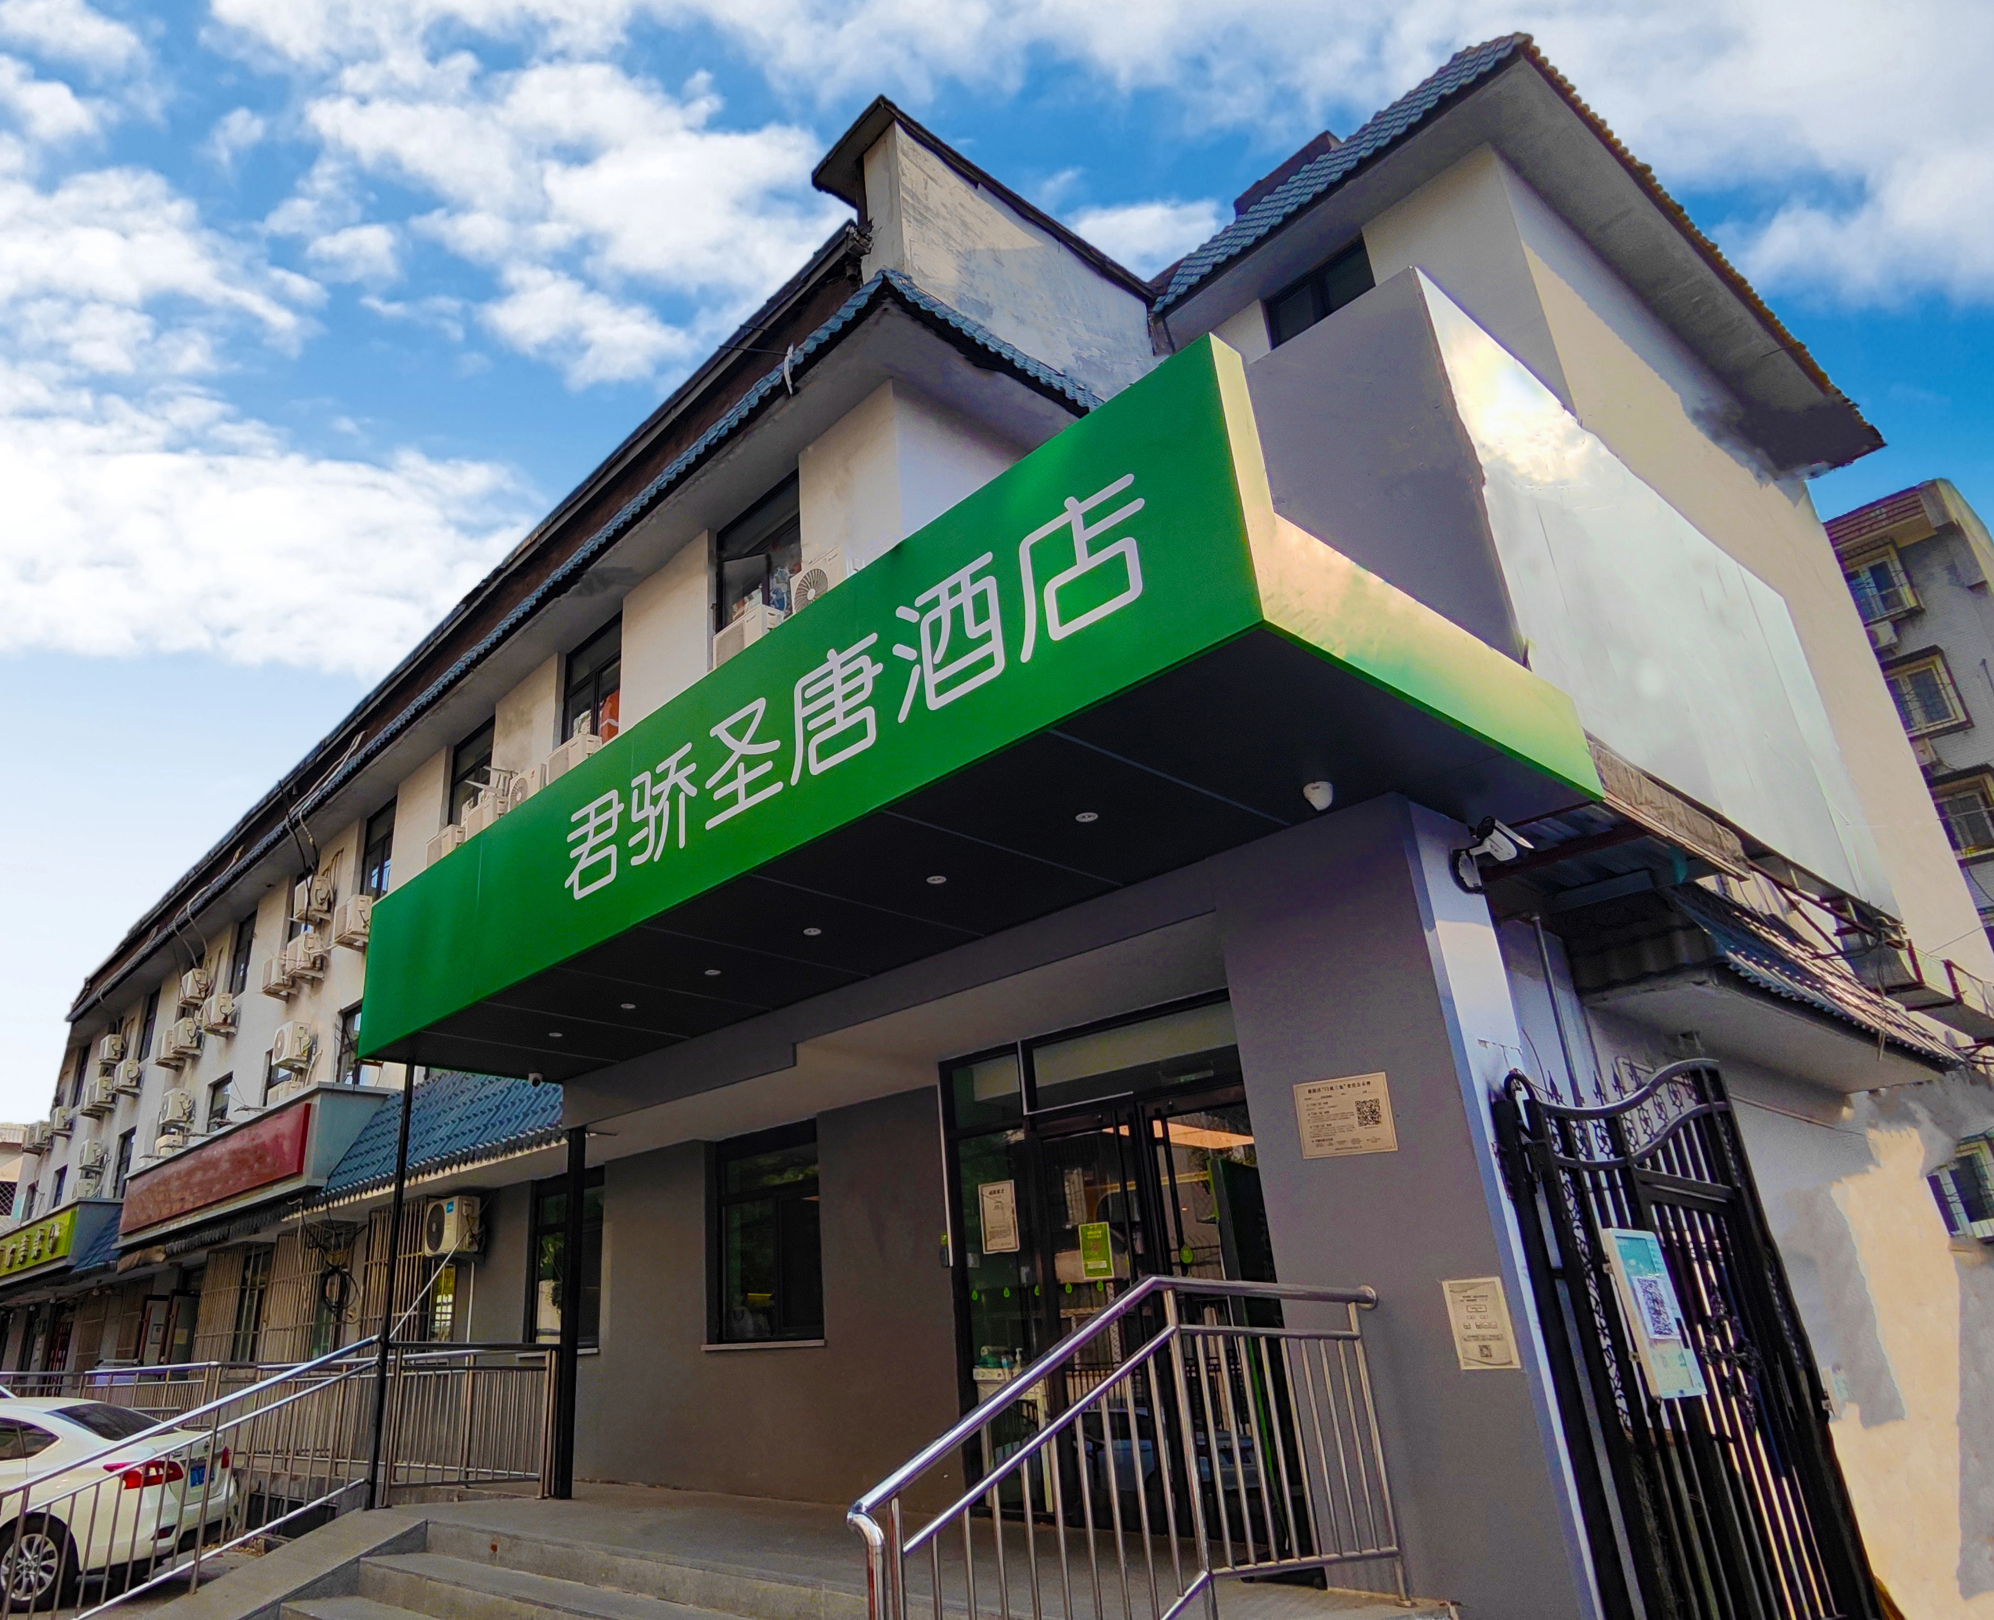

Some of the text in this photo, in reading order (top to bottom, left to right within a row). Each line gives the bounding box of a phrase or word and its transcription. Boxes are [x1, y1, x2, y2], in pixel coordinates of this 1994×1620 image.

[564, 473, 1145, 901] 君骄圣唐酒店
